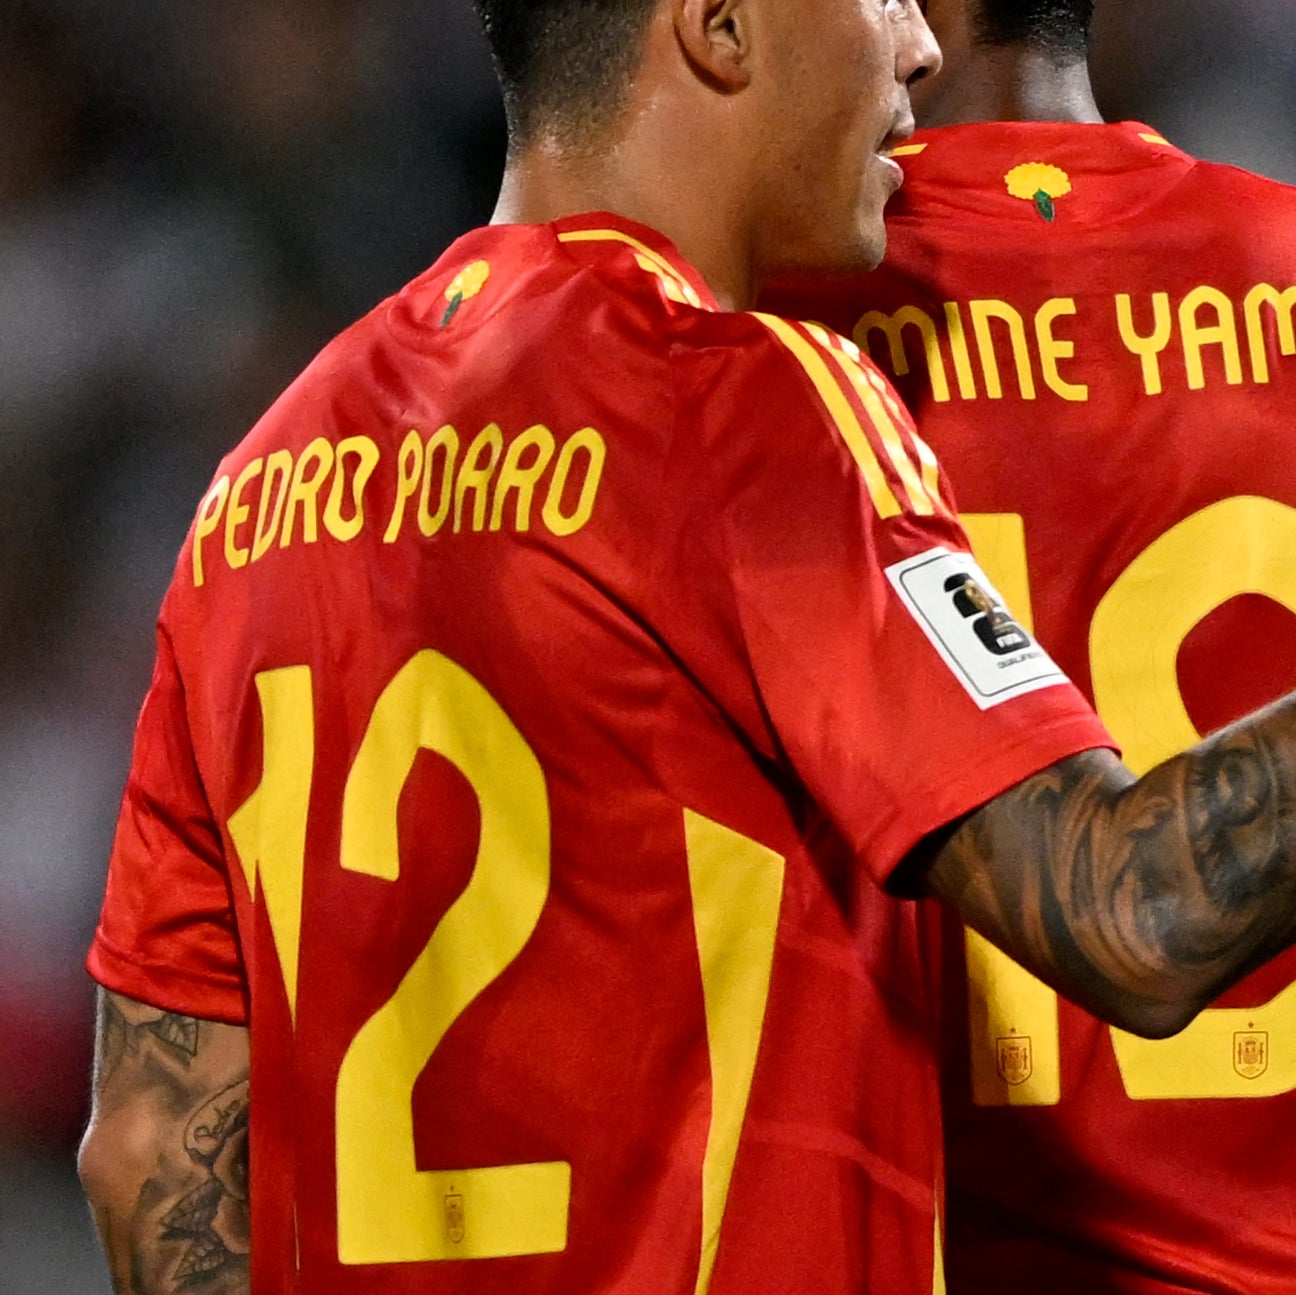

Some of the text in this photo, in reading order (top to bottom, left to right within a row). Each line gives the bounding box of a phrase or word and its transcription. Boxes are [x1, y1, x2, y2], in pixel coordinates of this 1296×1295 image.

[193, 423, 606, 586] PEDRO PORRO
[227, 649, 572, 1265] 12
